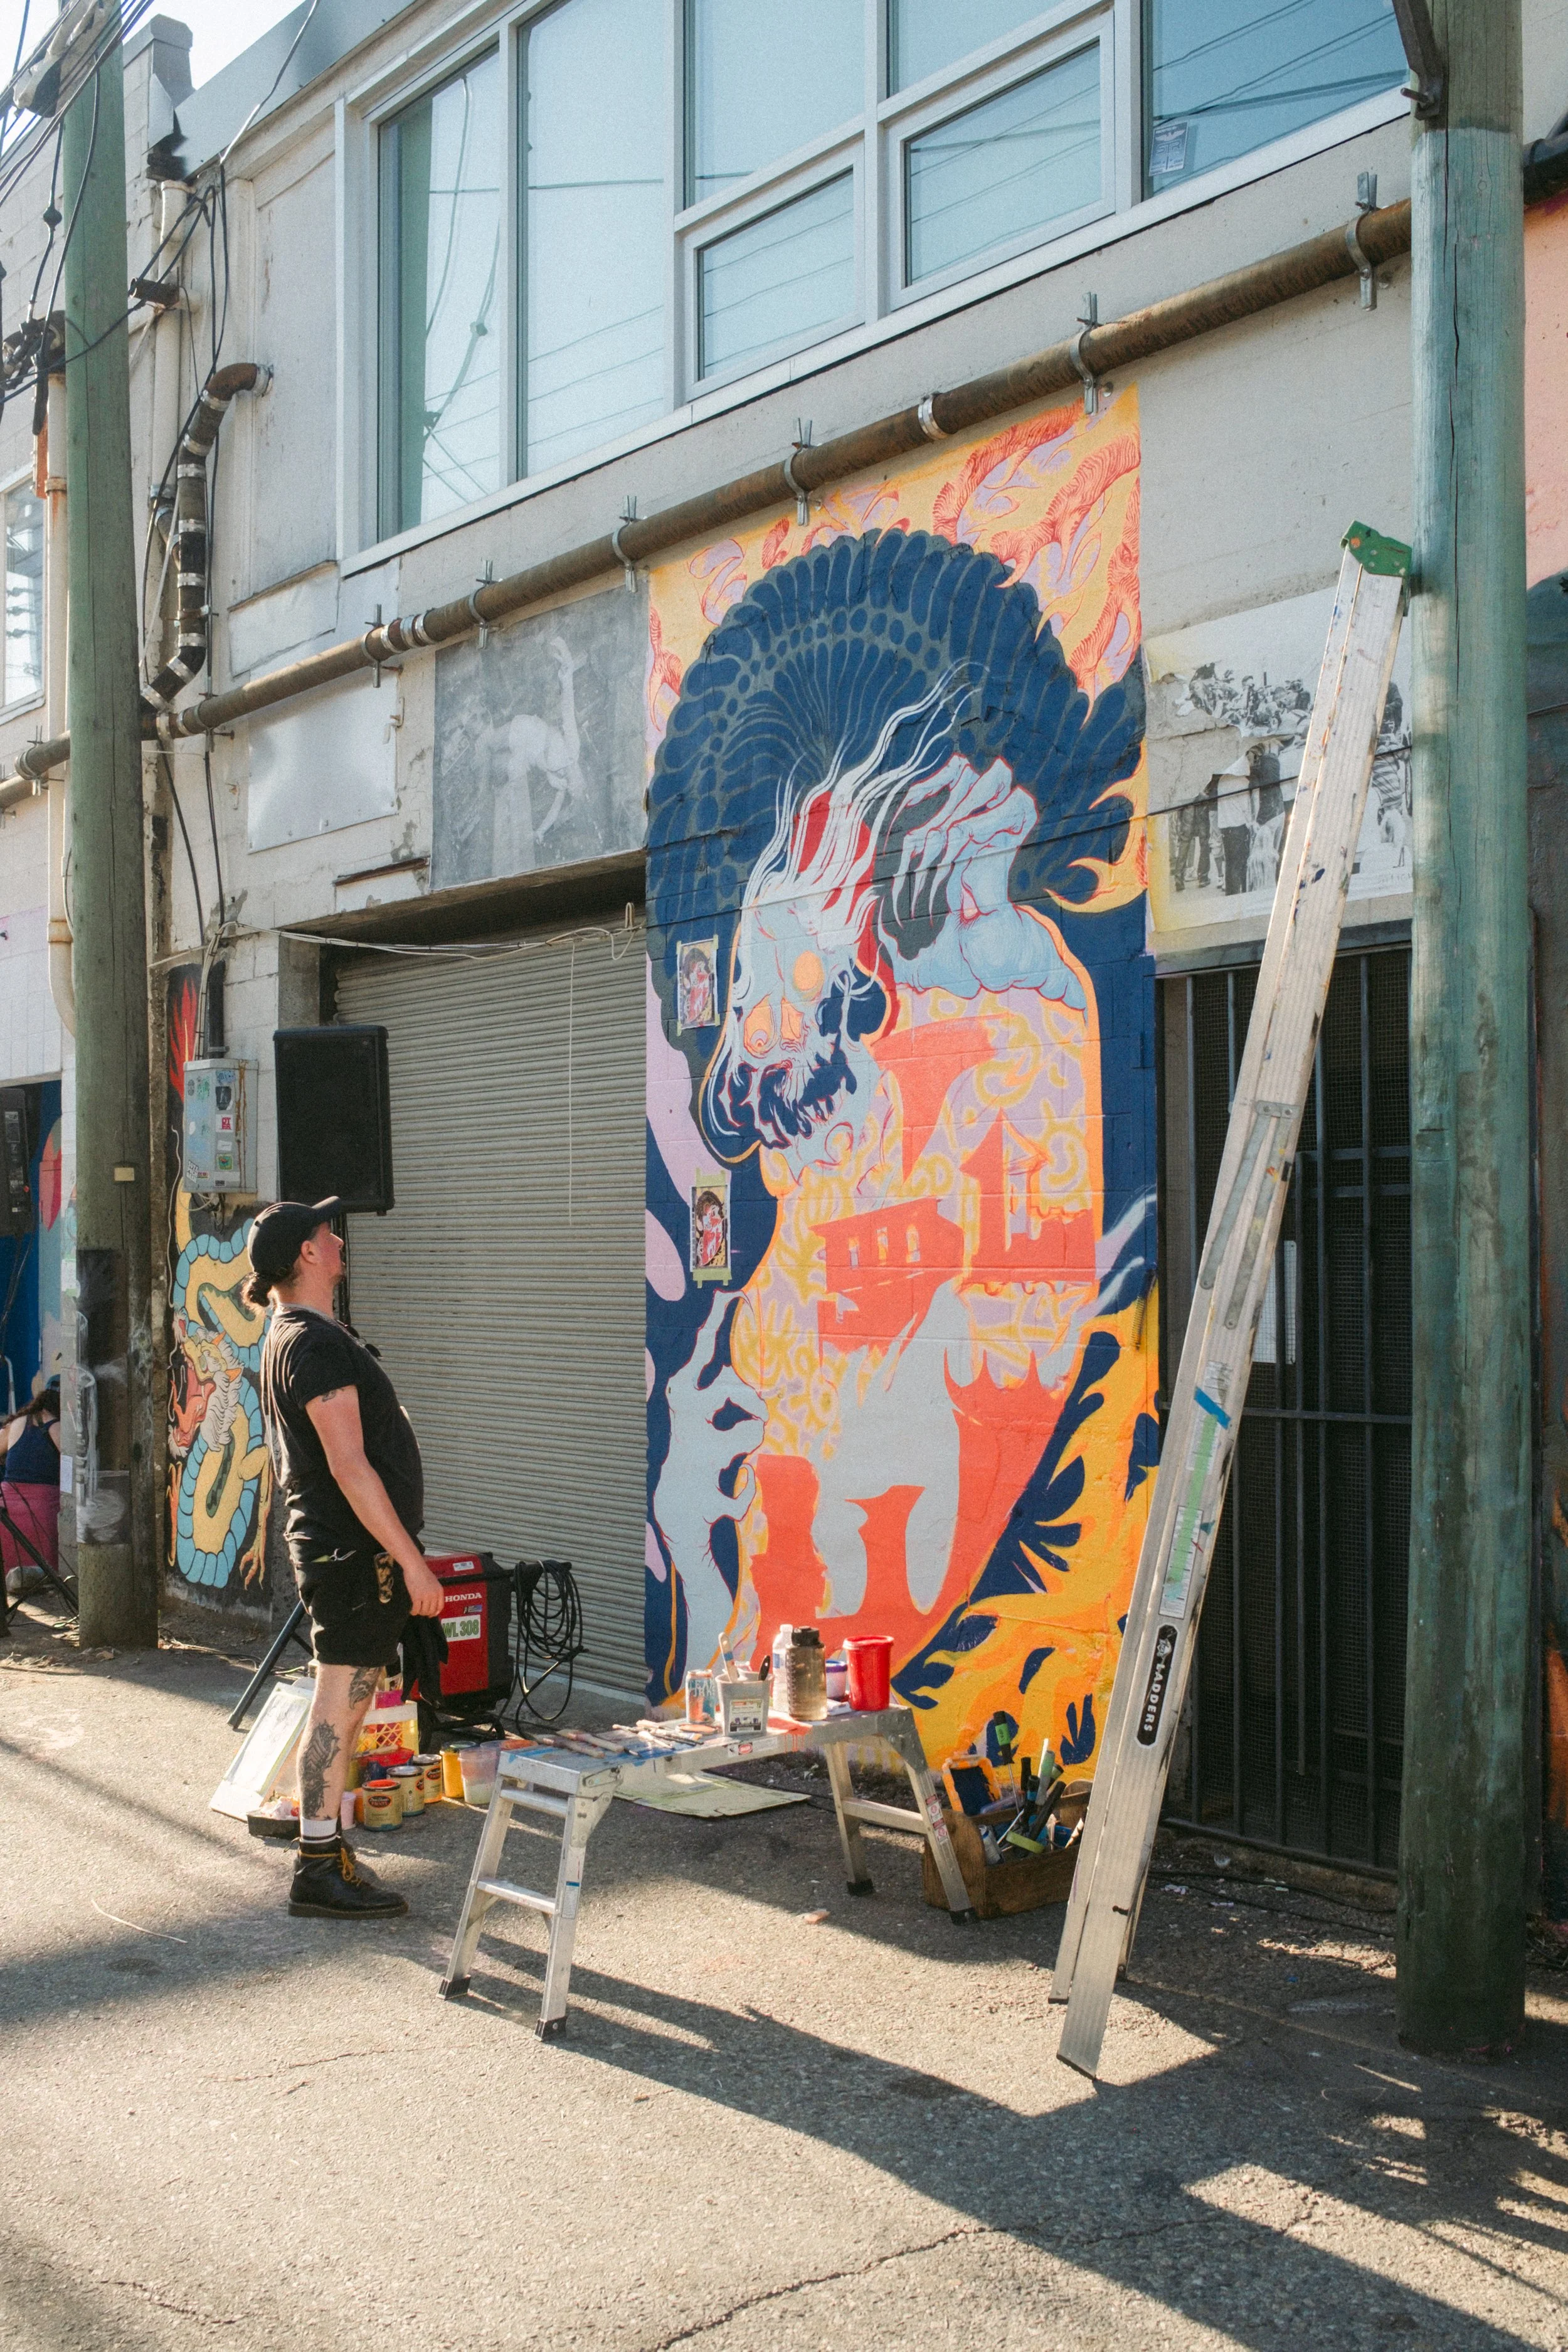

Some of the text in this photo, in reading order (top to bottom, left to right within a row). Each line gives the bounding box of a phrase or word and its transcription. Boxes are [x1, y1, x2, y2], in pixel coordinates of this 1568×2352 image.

[445, 1592, 482, 1602] HONDA
[460, 1619, 479, 1636] 308
[1143, 1663, 1165, 1732] LADDERS
